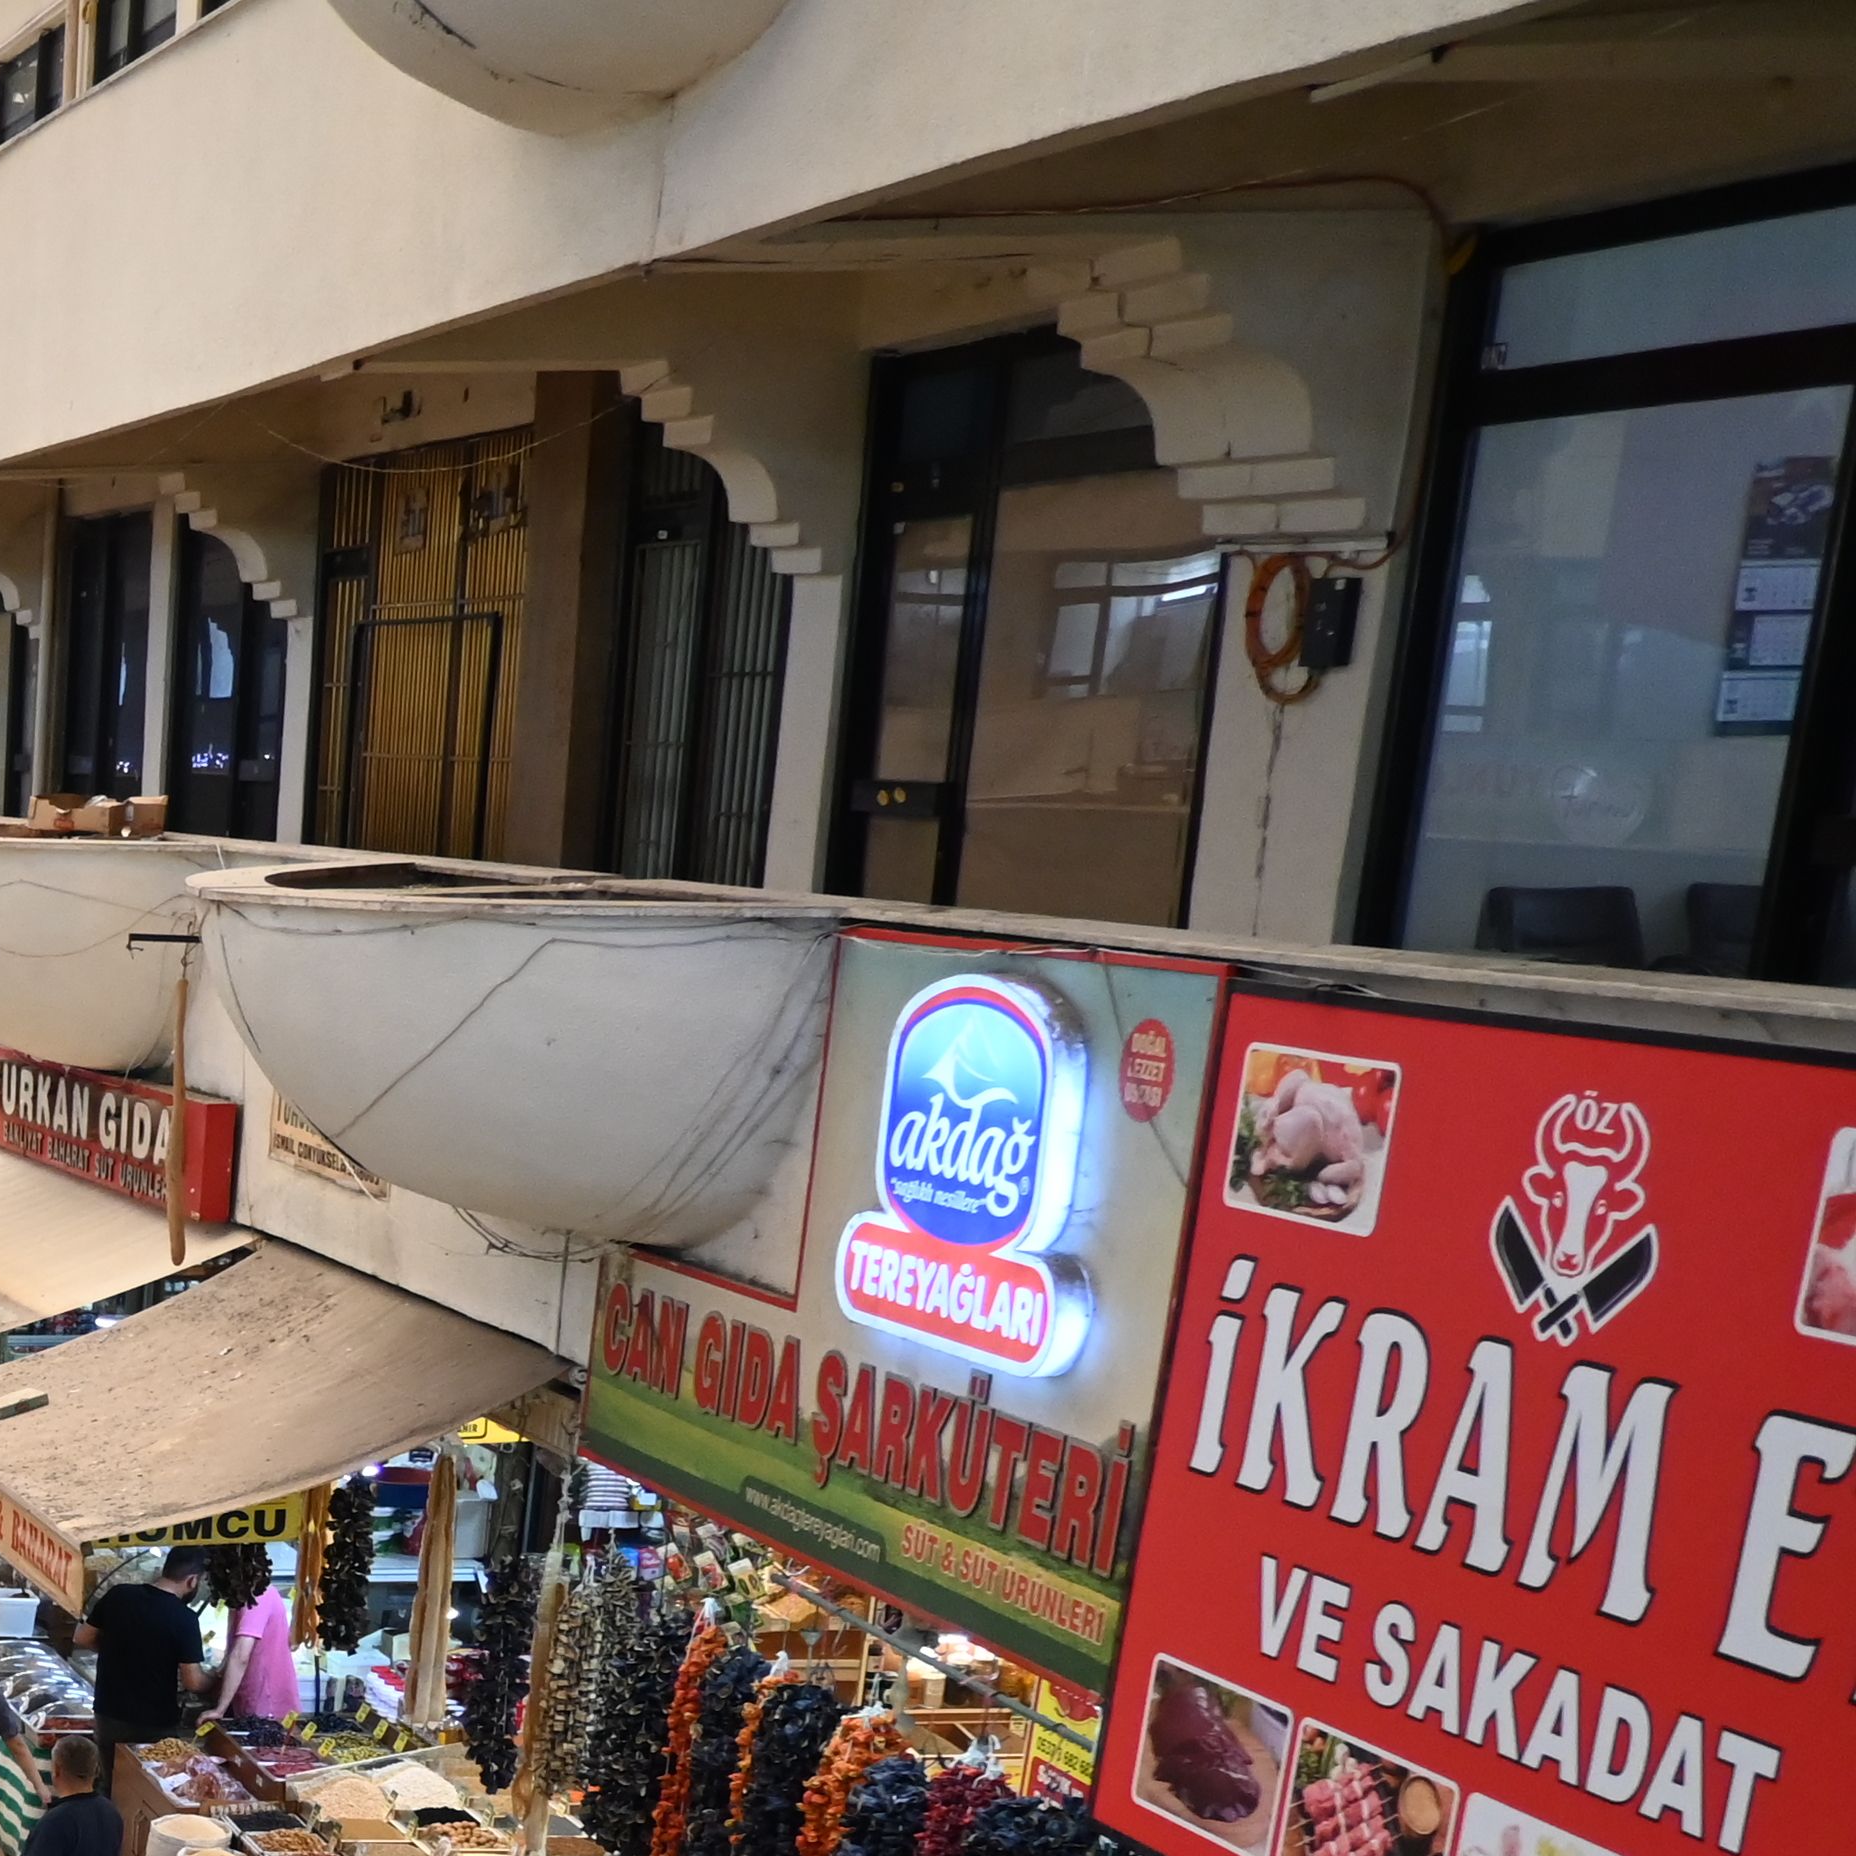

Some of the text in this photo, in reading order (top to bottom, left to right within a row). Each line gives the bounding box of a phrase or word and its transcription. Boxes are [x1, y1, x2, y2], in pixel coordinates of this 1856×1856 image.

[48, 1140, 90, 1174] BAHARAT
[98, 1093, 174, 1166] GIDA
[889, 1092, 1037, 1219] akdağ
[1575, 1089, 1618, 1135] ÖZ
[849, 1239, 1045, 1348] TEREYAĞLARI
[601, 1280, 1140, 1580] CAN GIDA ŞARKÜTERİ
[1188, 1254, 1856, 1705] İKRAM E
[11, 1510, 73, 1596] BAHARAT
[901, 1521, 1107, 1646] SÜT & SÜT ÜRÜNLERİ
[1258, 1553, 1783, 1856] VE SAKADAT
